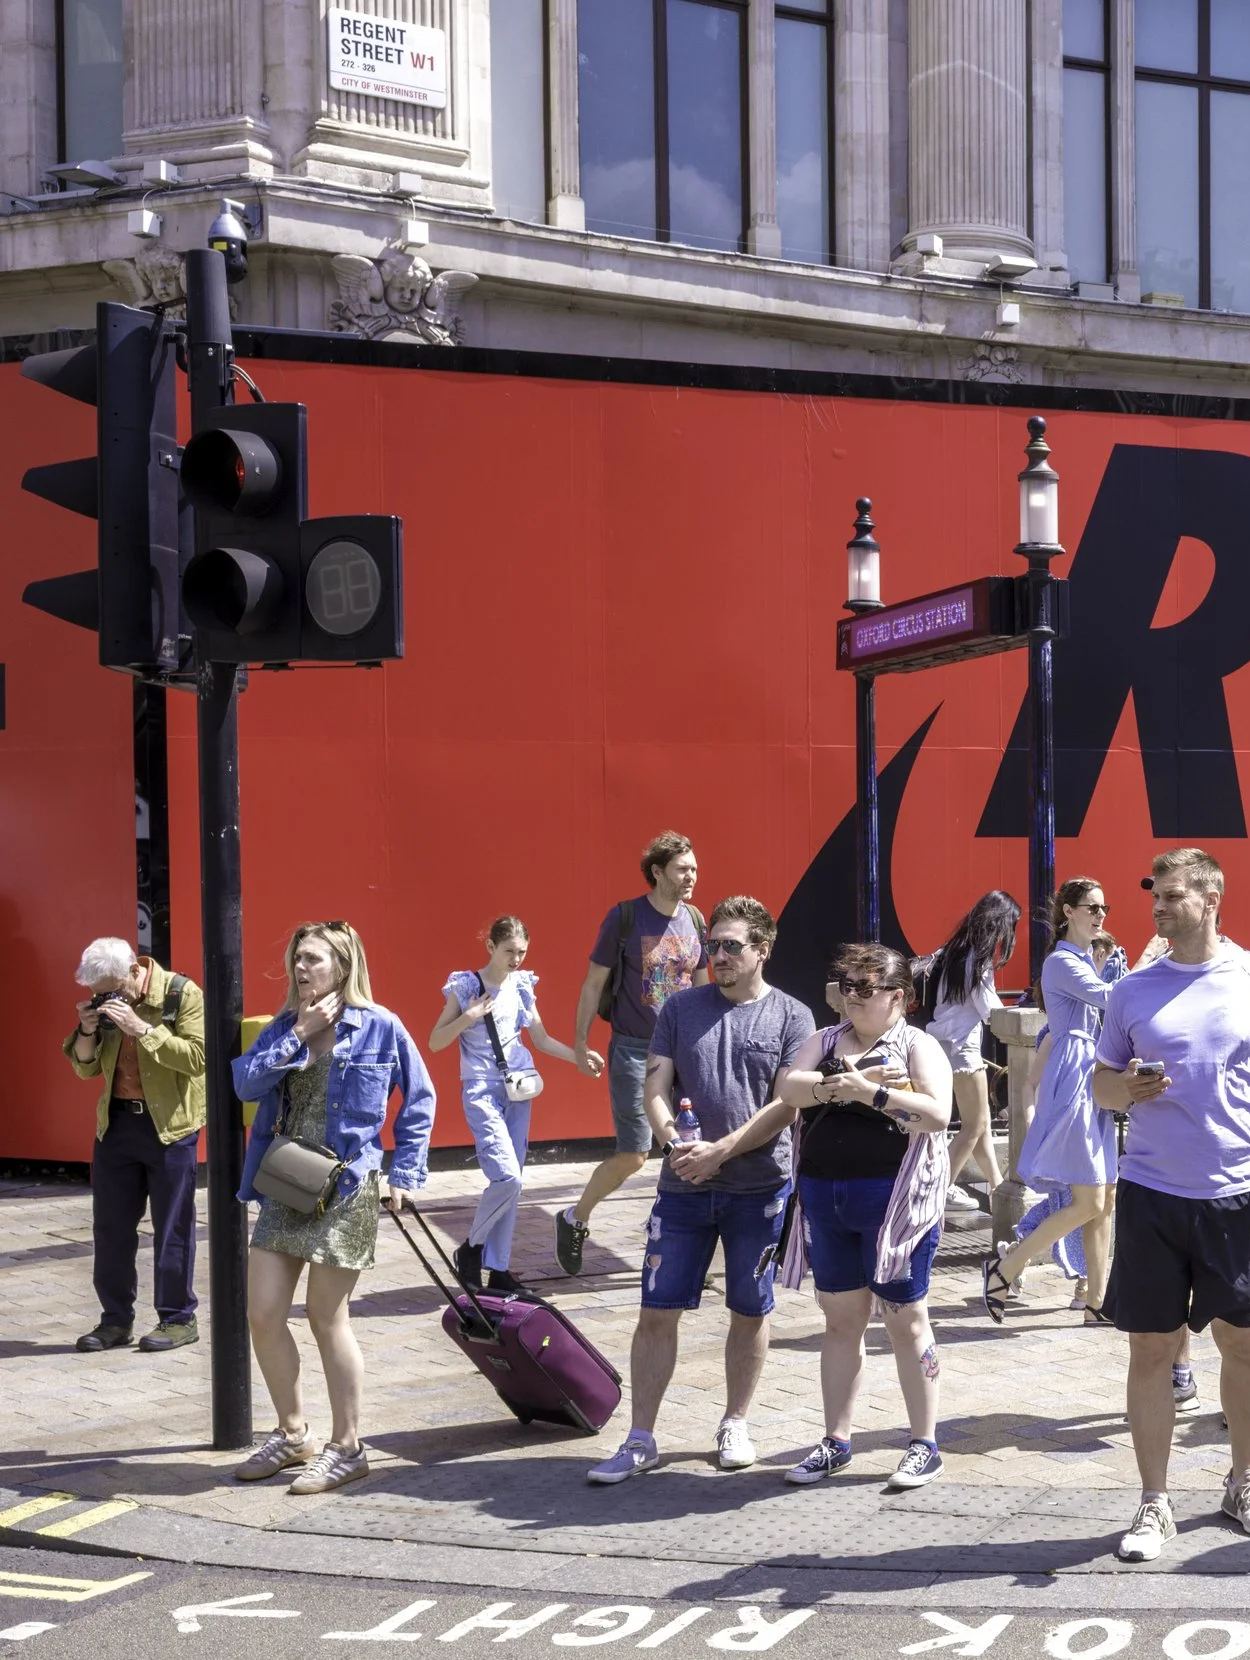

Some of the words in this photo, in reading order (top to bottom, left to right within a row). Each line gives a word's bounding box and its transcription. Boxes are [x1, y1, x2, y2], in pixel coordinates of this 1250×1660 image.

[340, 17, 406, 45] REGENT
[341, 38, 404, 65] STREET
[410, 51, 436, 72] W1
[341, 58, 355, 69] 272
[362, 62, 376, 73] 326
[341, 77, 359, 88] CITY
[361, 81, 371, 90] OF
[373, 83, 428, 101] WESTMINSTER
[856, 621, 891, 648] OXFORD
[892, 611, 924, 639] CIRCUS
[924, 599, 967, 631] STATION
[319, 1600, 816, 1652] RIGHT
